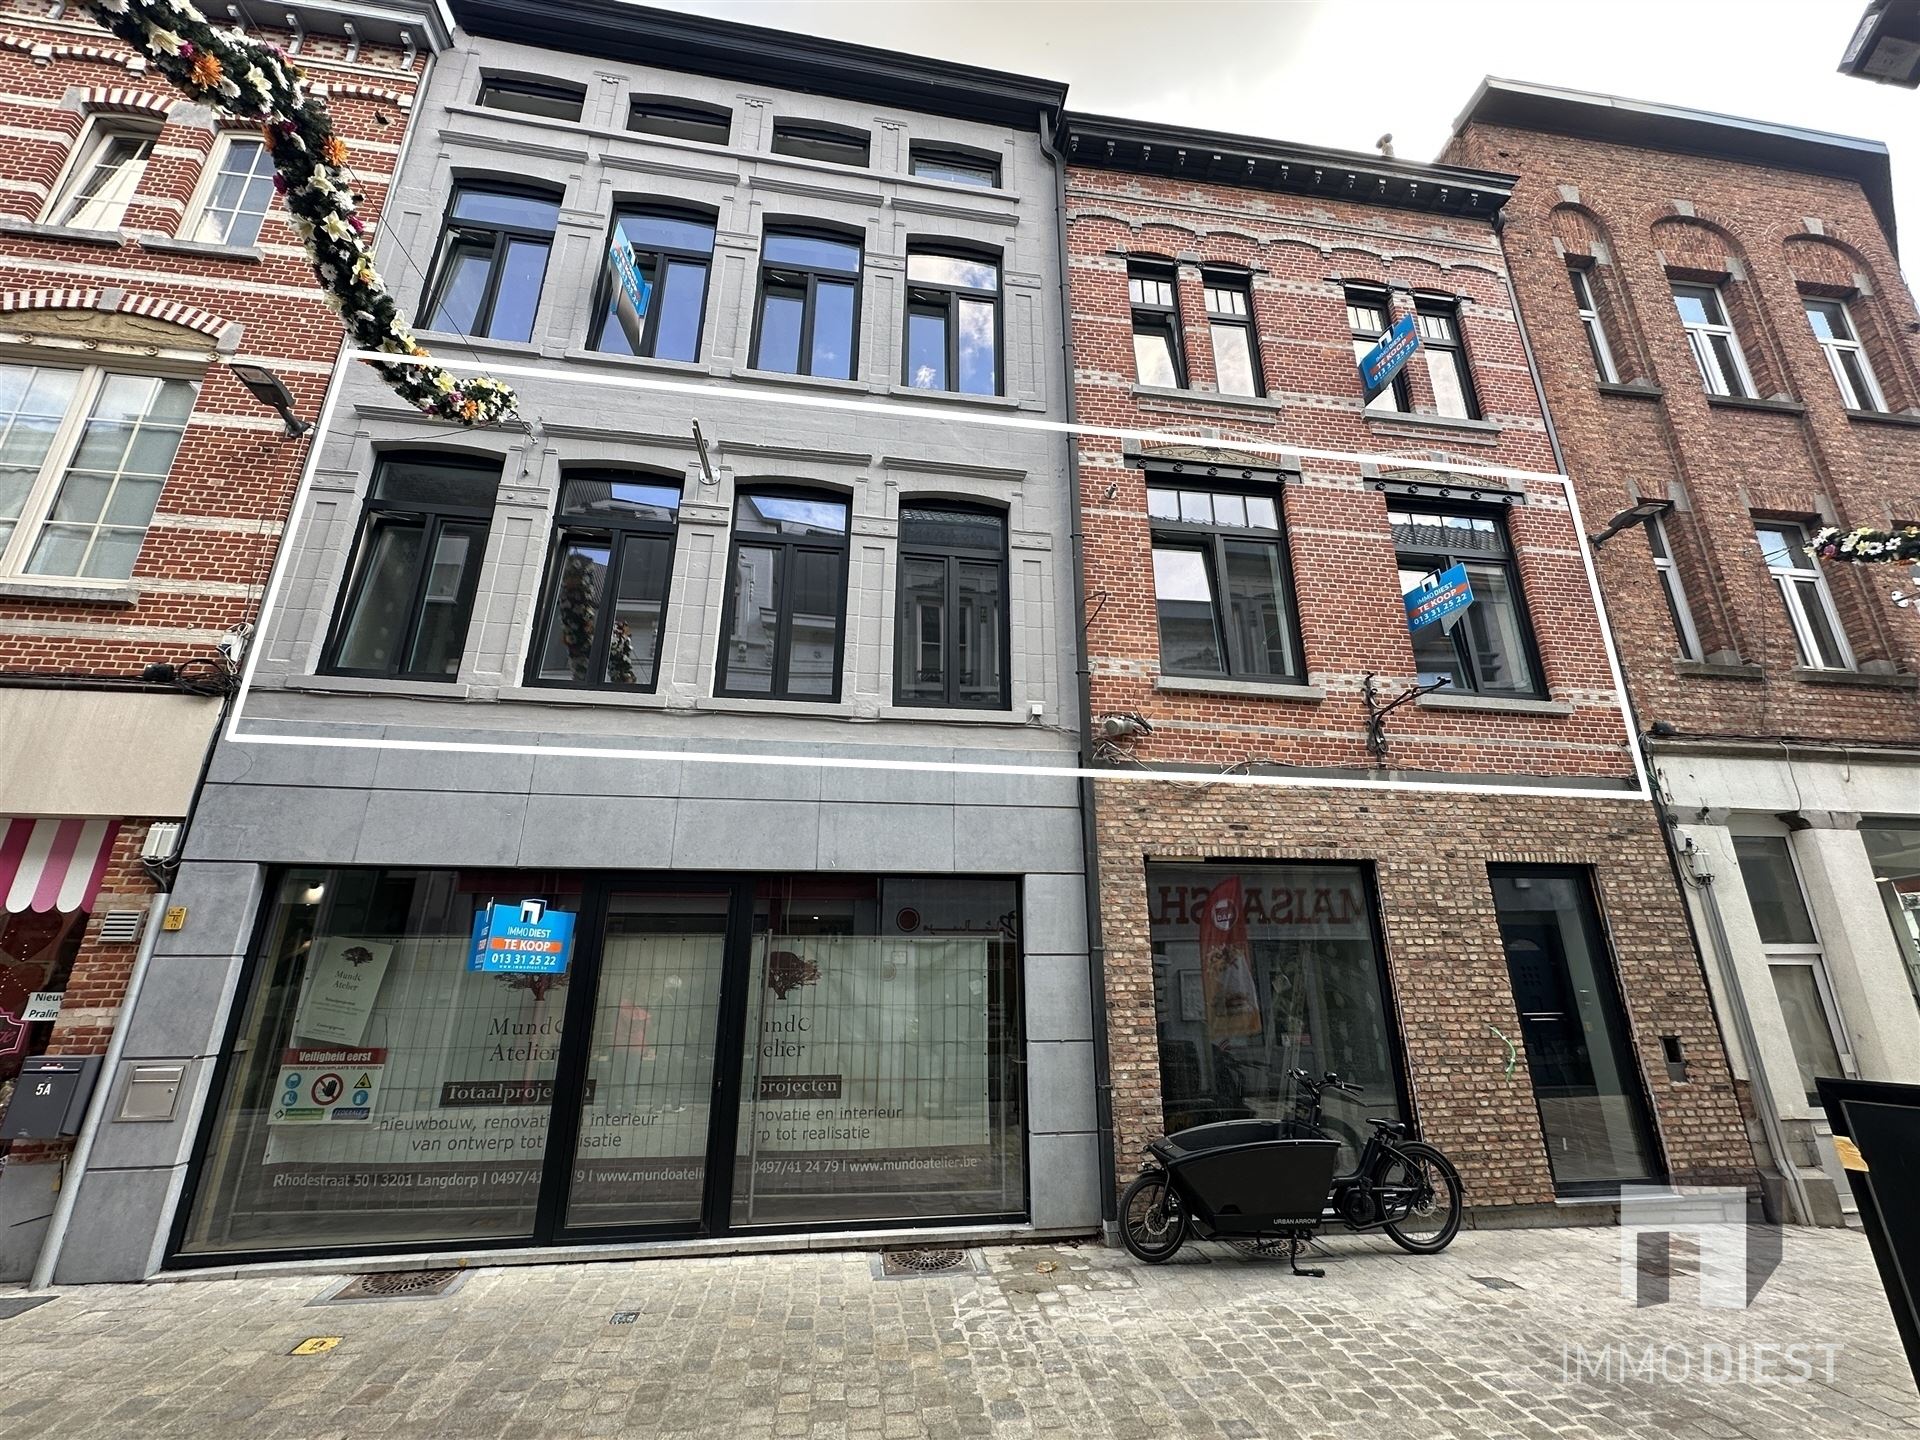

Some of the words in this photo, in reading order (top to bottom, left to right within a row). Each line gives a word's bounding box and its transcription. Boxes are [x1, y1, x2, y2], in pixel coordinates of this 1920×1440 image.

[1418, 603, 1430, 613] TE
[1431, 588, 1457, 607] KOOP
[1414, 613, 1429, 625] 013
[1431, 606, 1441, 616] 31
[1443, 600, 1454, 610] 25
[1456, 593, 1467, 603] 22
[504, 939, 517, 950] TE
[519, 940, 551, 952] KOOP
[492, 953, 511, 964] 013
[514, 954, 525, 964] 31
[529, 955, 541, 965] 25
[544, 956, 556, 966] 22
[28, 1009, 59, 1018] Pralin
[299, 1051, 347, 1063] Veiligheid
[347, 1052, 372, 1062] eerst
[35, 1083, 52, 1096] 5A
[816, 1109, 834, 1121] en
[840, 1106, 903, 1120] interieur
[380, 1116, 477, 1132] nieuwbouw,
[484, 1114, 550, 1130] renovati
[591, 1112, 658, 1126] interieur
[776, 1129, 797, 1141] tot
[802, 1126, 870, 1140] realisatie
[412, 1139, 441, 1151] van
[447, 1136, 514, 1152] ontwerp
[521, 1135, 542, 1149] tot
[805, 1161, 820, 1173] 24
[824, 1160, 839, 1173] 79
[850, 1155, 978, 1172] www.mundoatelier.be
[273, 1173, 350, 1187] Rhodestraat
[353, 1174, 369, 1187] 50
[381, 1174, 413, 1187] 3201
[417, 1173, 478, 1190] Langdorp
